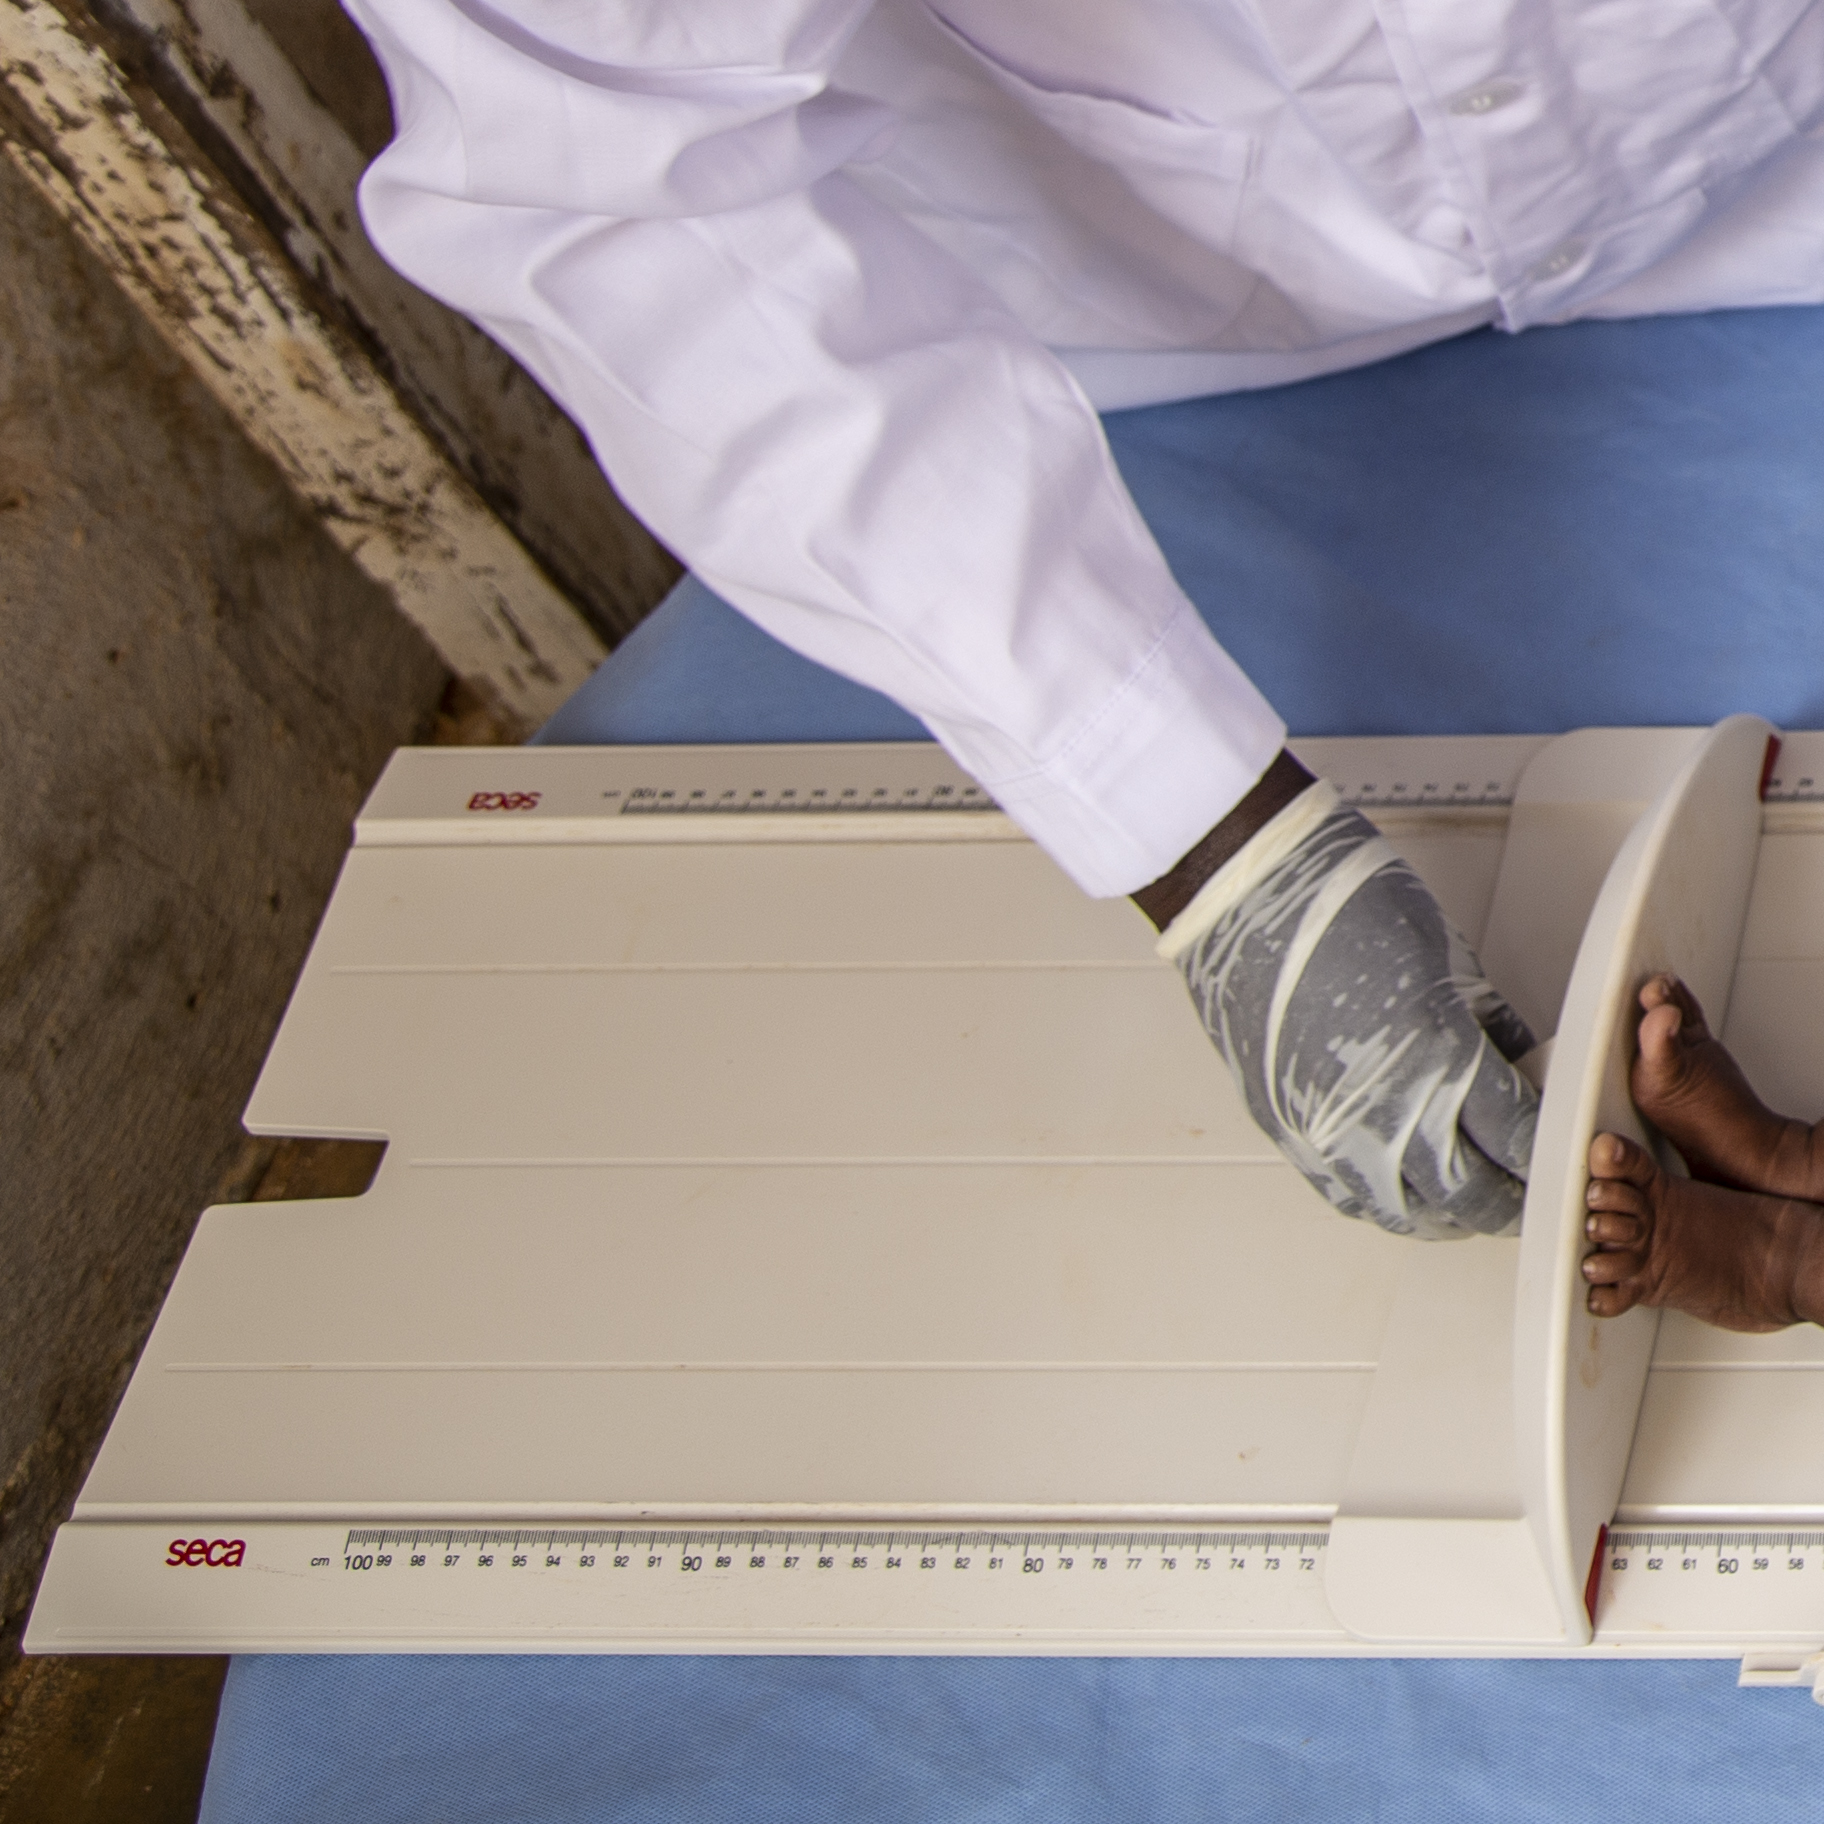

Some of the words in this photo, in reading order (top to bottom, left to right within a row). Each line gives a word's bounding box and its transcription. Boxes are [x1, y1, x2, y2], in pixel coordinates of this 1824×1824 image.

[467, 790, 542, 812] seca
[165, 1538, 247, 1568] seca
[310, 1557, 330, 1567] cm
[344, 1555, 373, 1571] 100
[376, 1554, 393, 1567] 99
[410, 1555, 426, 1567] 98
[443, 1555, 460, 1567] 97
[478, 1555, 494, 1567] 96
[511, 1555, 527, 1567] 95
[545, 1555, 561, 1567] 94
[579, 1555, 595, 1567] 93
[613, 1555, 629, 1568] 92
[647, 1556, 662, 1568] 91
[681, 1556, 702, 1572] 90
[715, 1556, 731, 1568] 89
[749, 1556, 765, 1568] 88
[783, 1556, 800, 1568] 87
[817, 1556, 834, 1568] 86
[851, 1557, 867, 1569] 85
[885, 1557, 901, 1569] 84
[920, 1557, 936, 1569] 83
[954, 1557, 970, 1569] 82
[988, 1557, 1003, 1569] 81
[1022, 1558, 1044, 1573] 80
[1058, 1558, 1073, 1569] 79
[1093, 1558, 1107, 1570] 78
[1127, 1558, 1142, 1569] 77
[1162, 1558, 1176, 1570] 76
[1196, 1558, 1210, 1570] 75
[1230, 1558, 1245, 1569] 74
[1265, 1558, 1280, 1570] 73
[1300, 1558, 1315, 1570] 72
[1612, 1558, 1628, 1570] 63
[1647, 1558, 1663, 1570] 62
[1682, 1558, 1697, 1570] 61
[1717, 1558, 1739, 1574] 60
[1753, 1558, 1769, 1570] 59
[1788, 1558, 1804, 1570] 58
